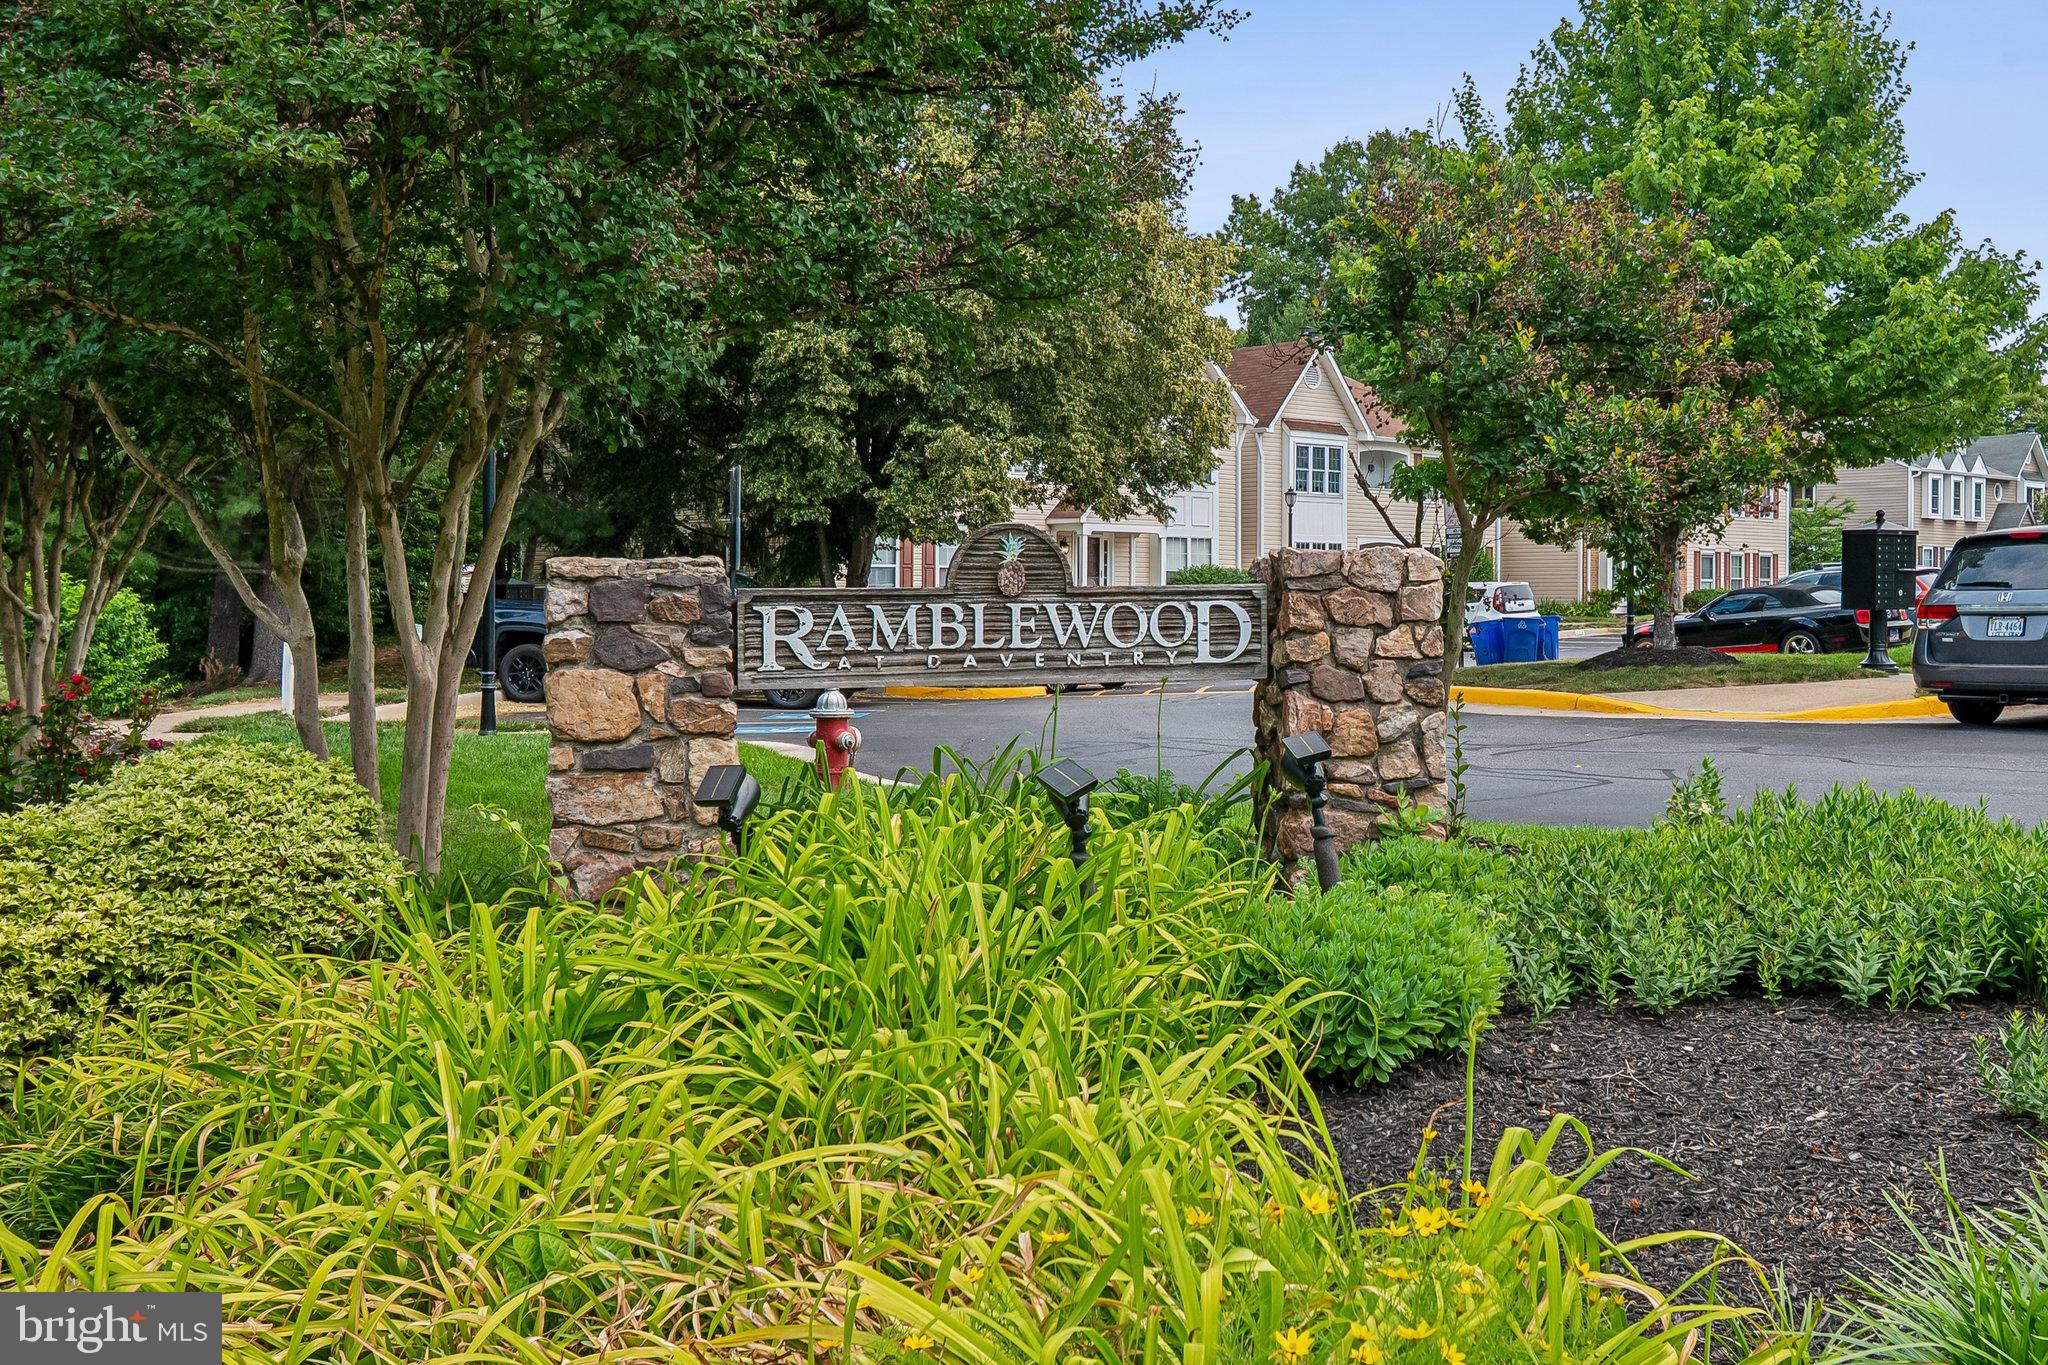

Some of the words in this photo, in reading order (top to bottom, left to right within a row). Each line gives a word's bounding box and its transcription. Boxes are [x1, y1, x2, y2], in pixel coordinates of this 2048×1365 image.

[752, 600, 1251, 671] RAMBLEWOOD
[837, 655, 885, 671] AT
[926, 651, 1178, 669] DAVENTRY
